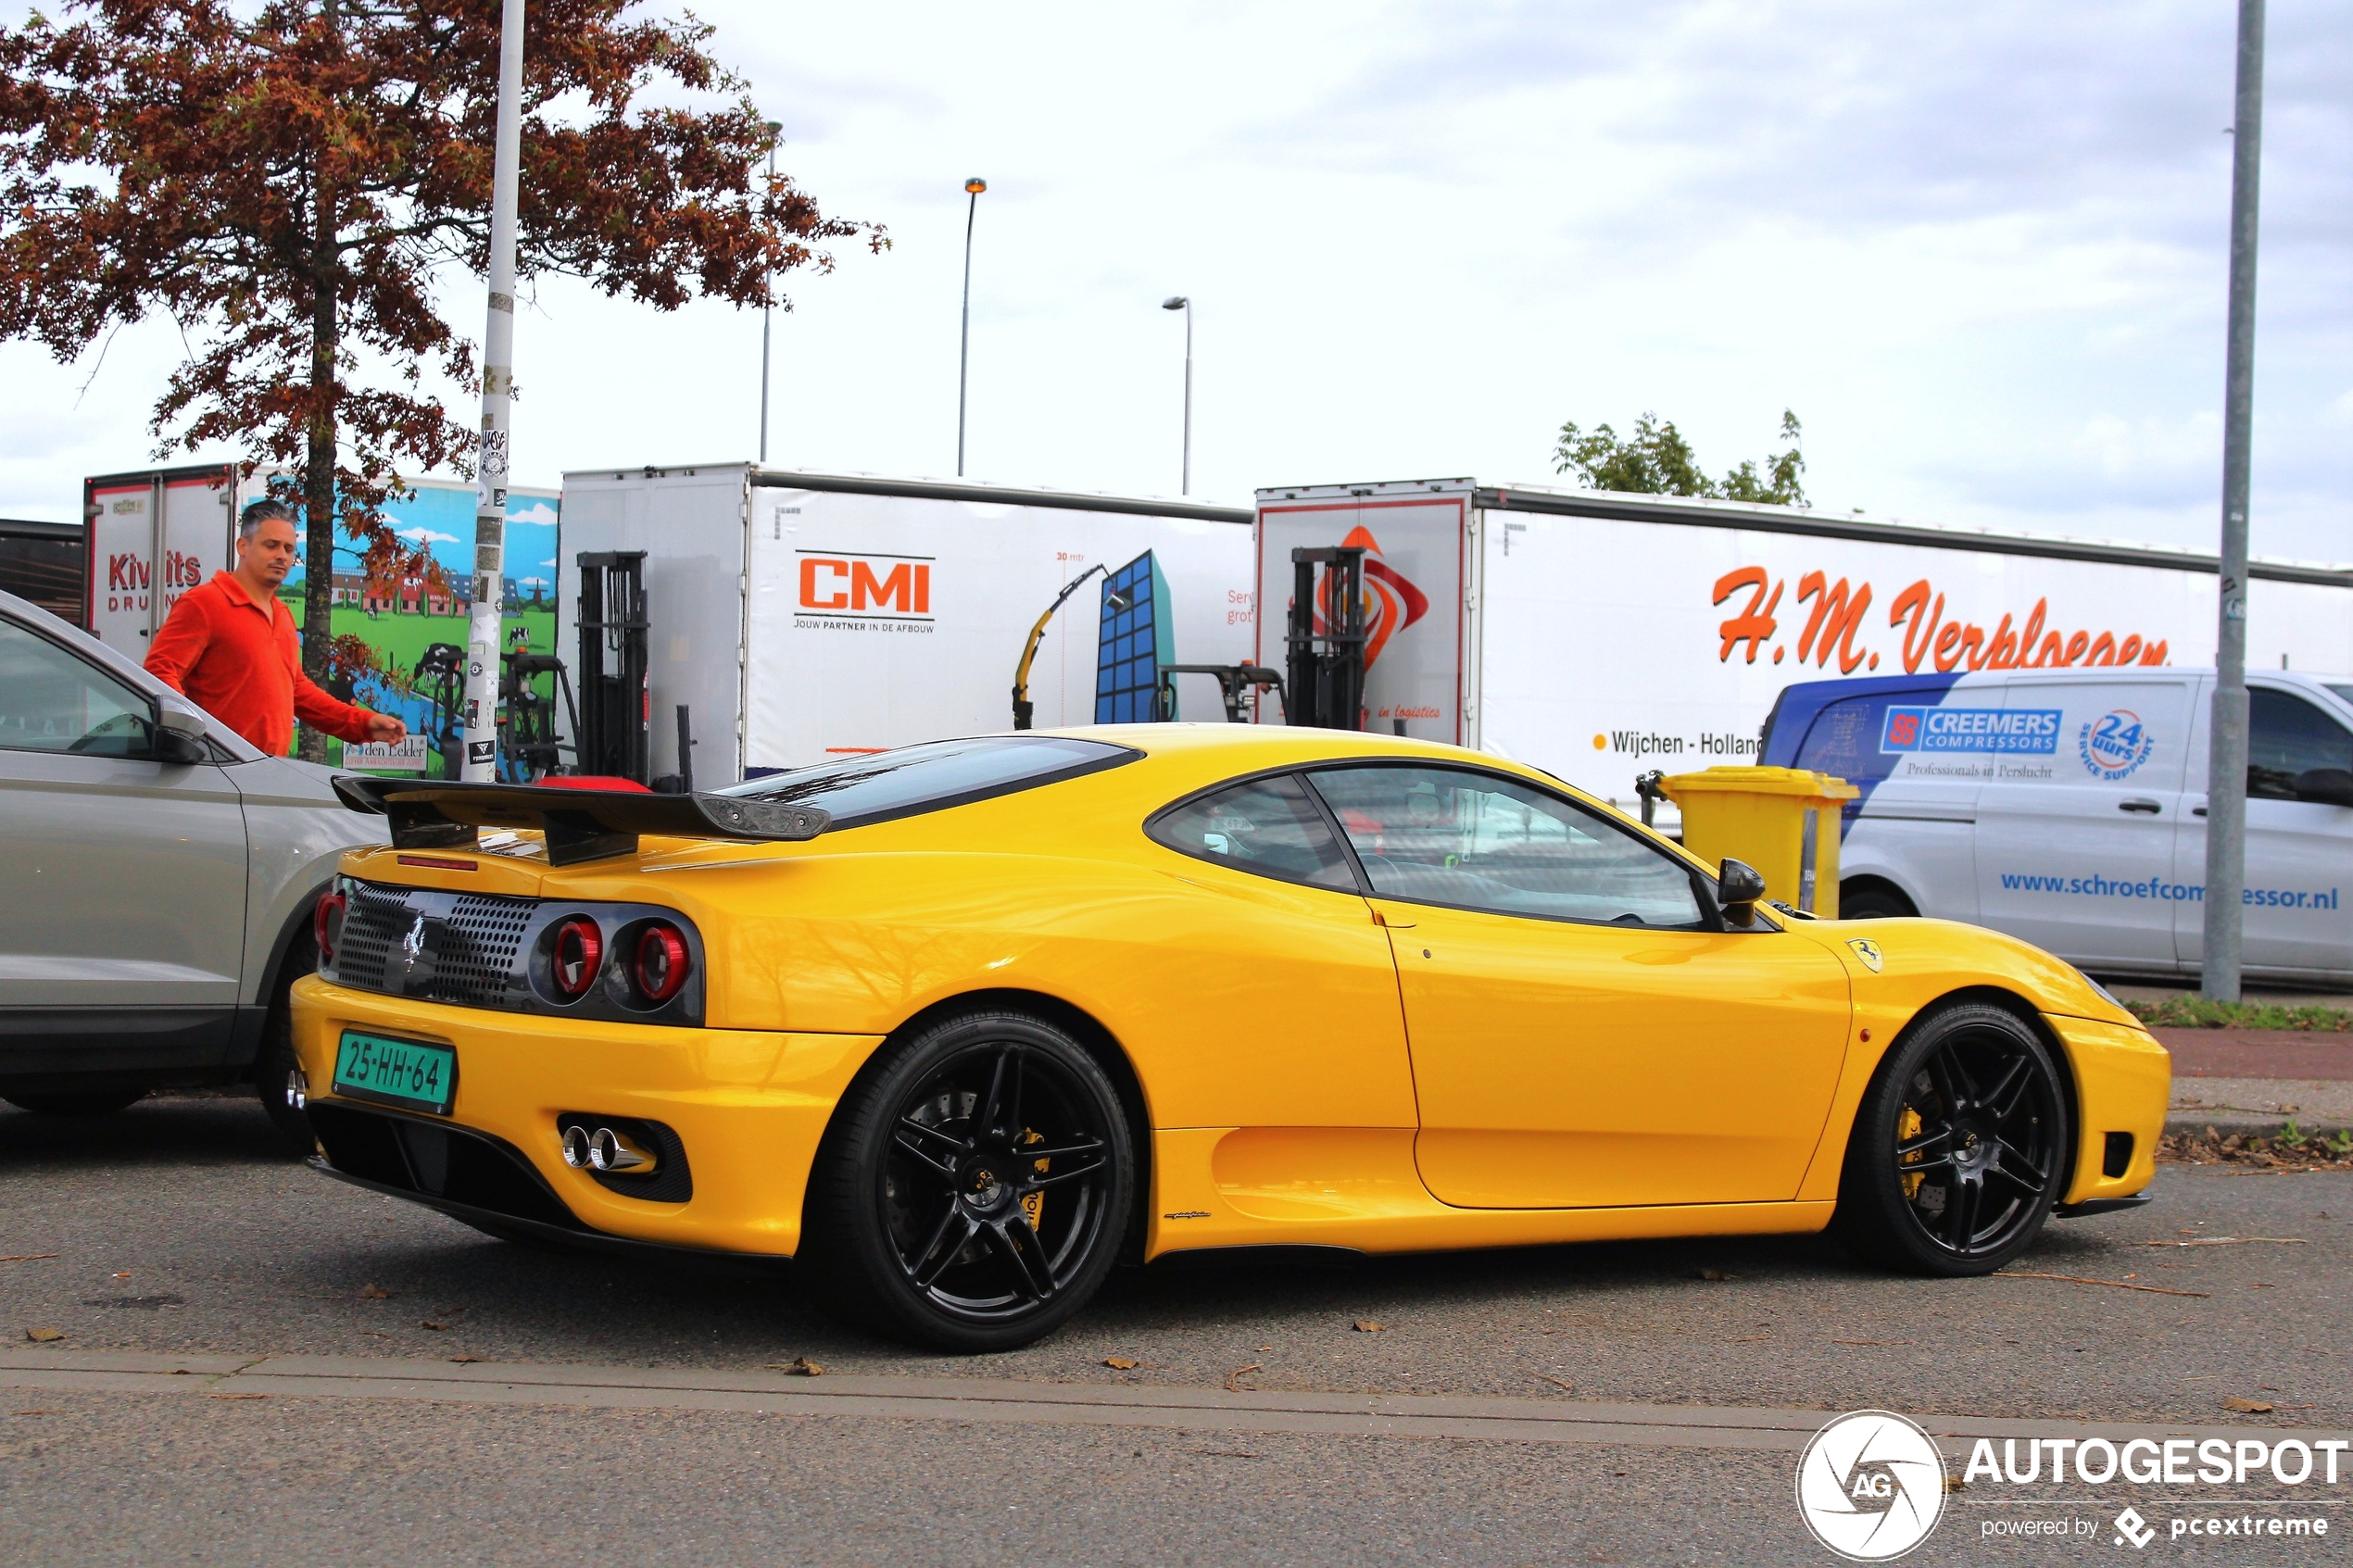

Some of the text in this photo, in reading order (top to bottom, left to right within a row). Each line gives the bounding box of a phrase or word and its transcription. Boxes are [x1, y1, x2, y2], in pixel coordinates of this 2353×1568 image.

[1057, 552, 1068, 560] 30
[108, 550, 202, 591] Kivits
[799, 558, 930, 613] CMI
[108, 594, 183, 612] DRUN
[824, 621, 866, 631] PARTNER
[869, 622, 879, 632] IN
[882, 623, 894, 632] DE
[897, 624, 935, 633] AFBOUW
[1378, 707, 1390, 718] in
[1394, 704, 1441, 721] logistics
[1928, 712, 2057, 735] CREEMERS
[2096, 714, 2143, 746] 24
[365, 740, 384, 757] den
[1612, 731, 1684, 759] Wijchen
[1925, 735, 2054, 750] COMPRESSORS
[2079, 722, 2155, 780] SERVICE SUPPORT
[2092, 736, 2134, 761] uurs
[1907, 761, 2053, 778] Professionals in Perslucht
[2001, 873, 2339, 909] www.schroefcomessor.nl
[346, 1040, 440, 1096] 25-HH-64
